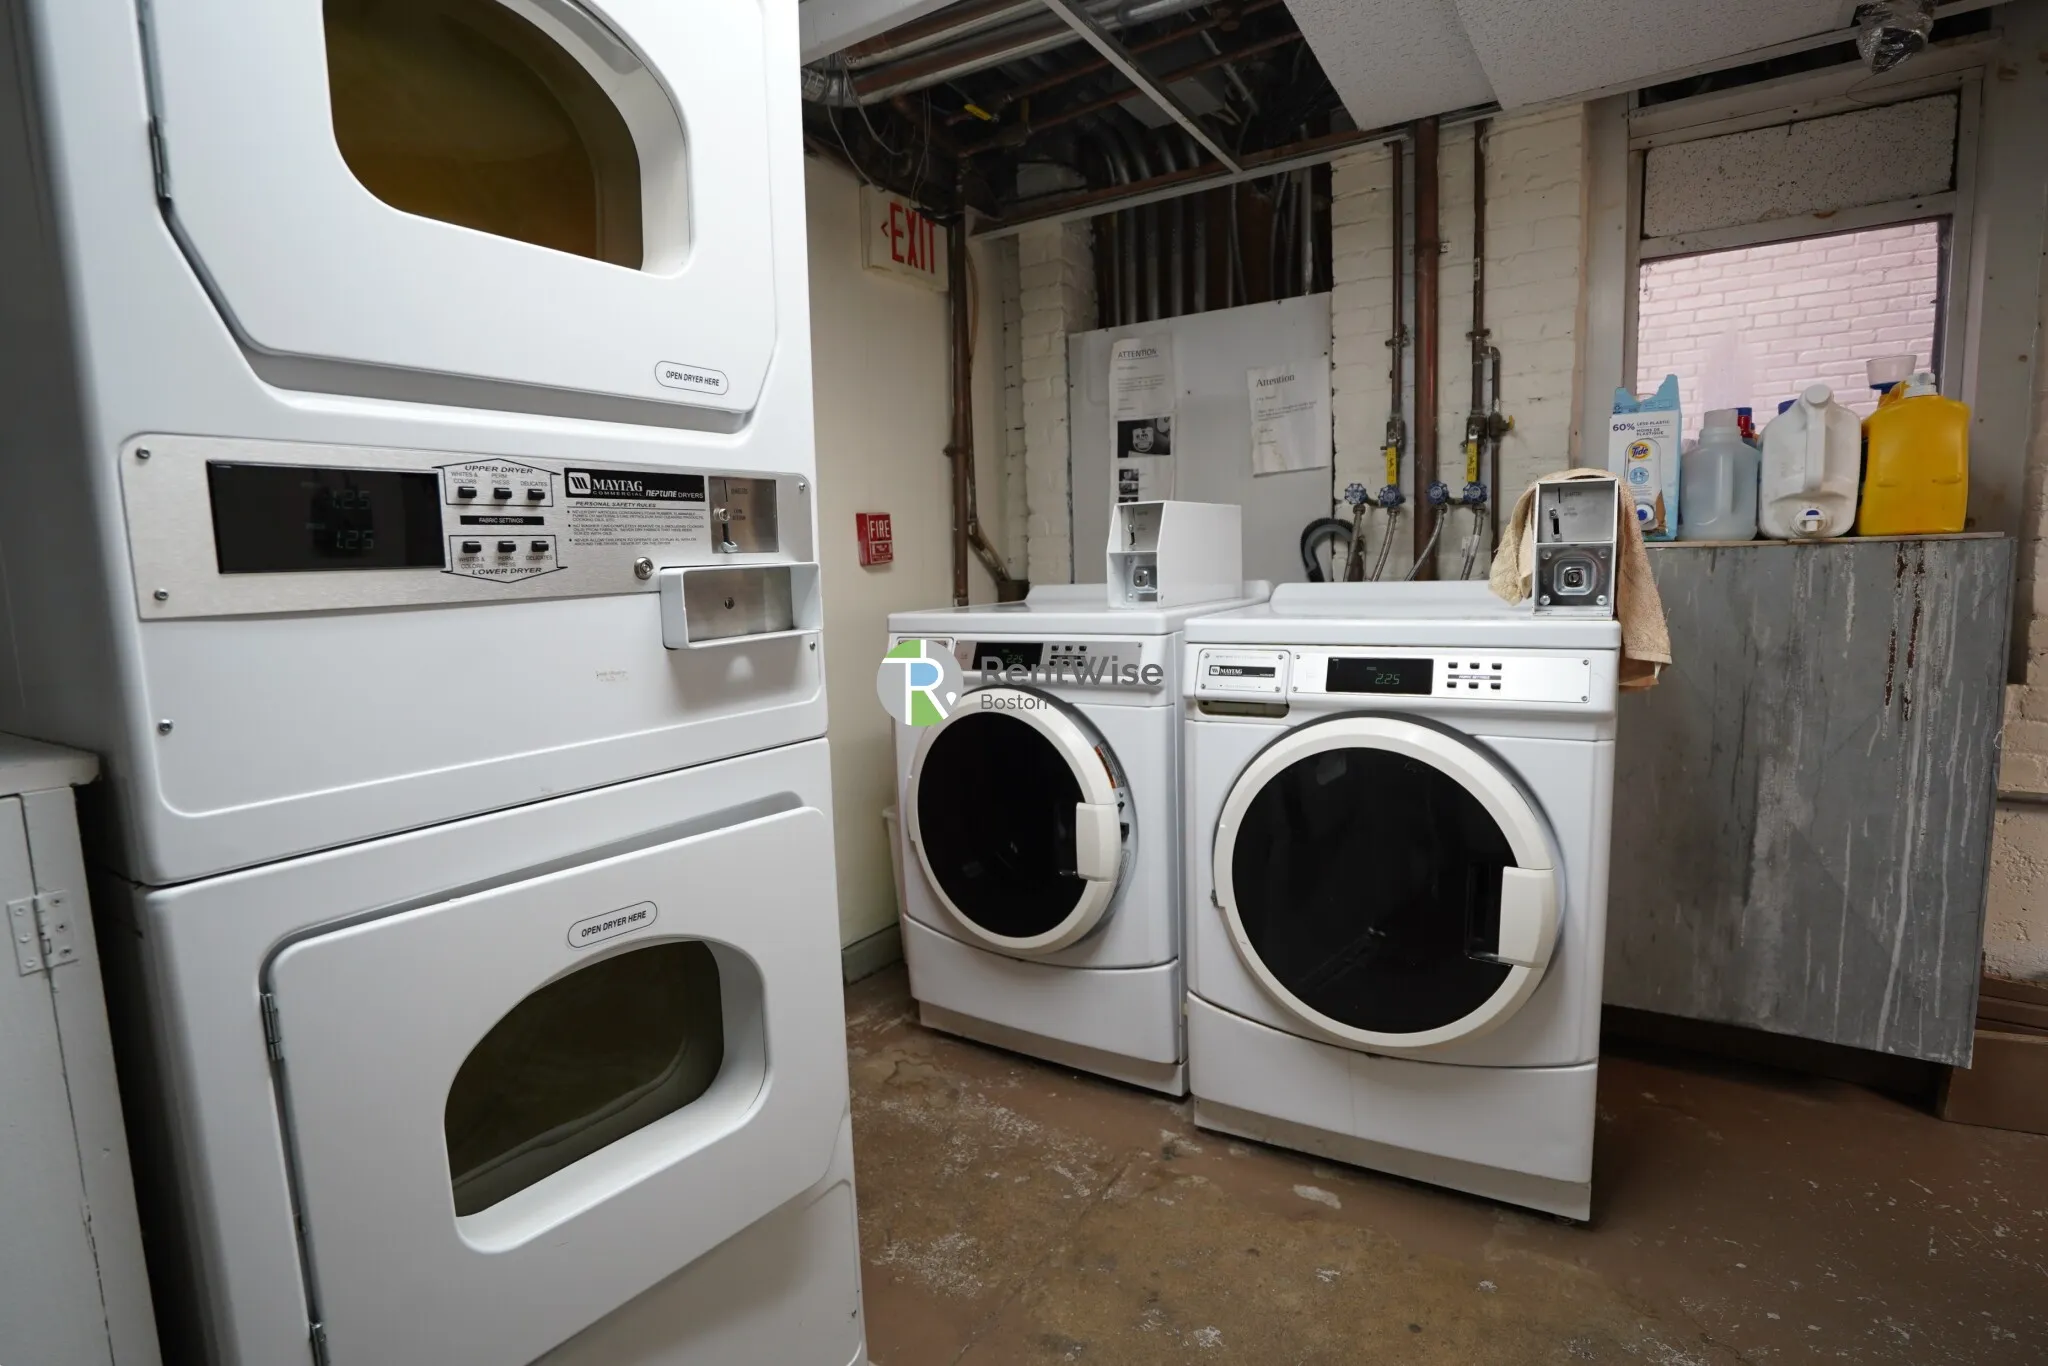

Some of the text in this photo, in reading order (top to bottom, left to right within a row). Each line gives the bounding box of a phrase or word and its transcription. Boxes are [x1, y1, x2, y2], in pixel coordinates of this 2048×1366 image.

[890, 202, 936, 274] EXIT
[1118, 348, 1157, 358] ATTENTION
[666, 370, 720, 386] OPEN DRYER HERE
[1256, 372, 1295, 387] Attention
[1612, 422, 1635, 431] 60%
[1632, 446, 1648, 457] Tide
[593, 479, 643, 492] MAYTAG
[870, 520, 890, 538] FIRE
[581, 910, 647, 937] OPEN DRYER HERE
